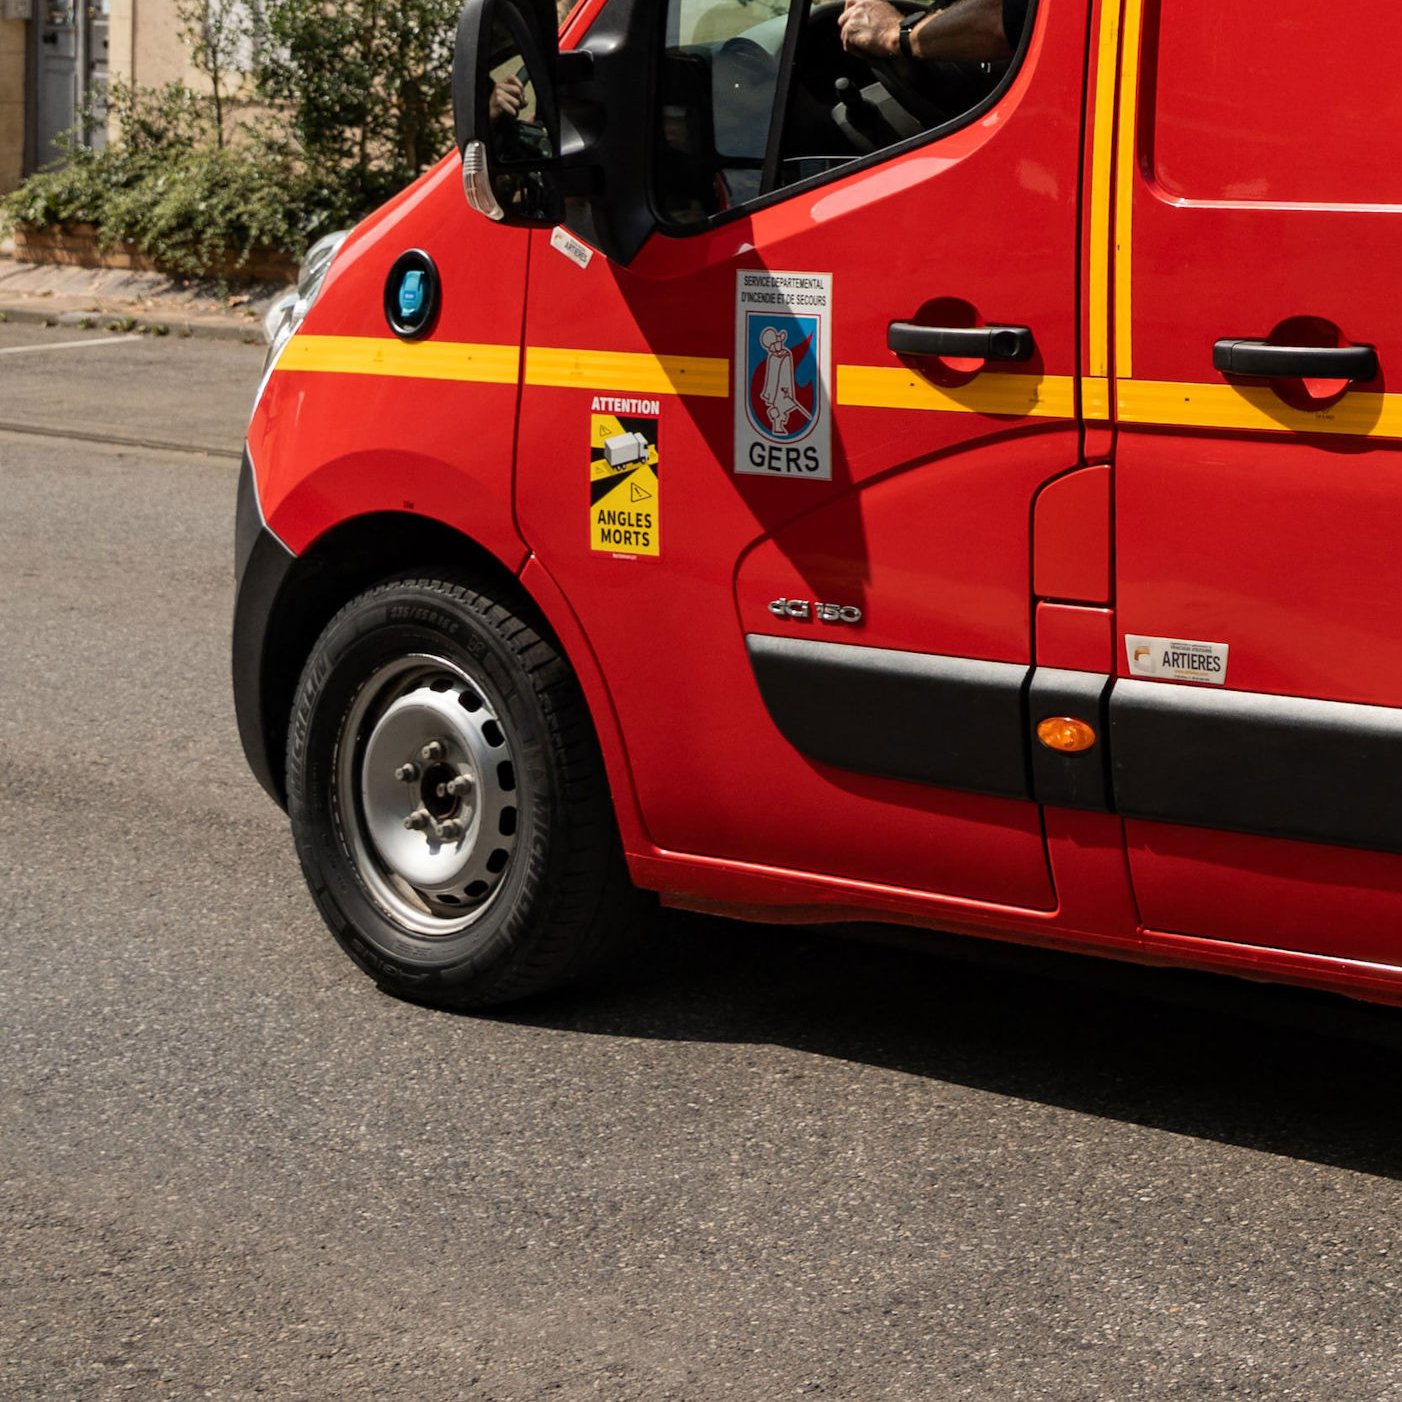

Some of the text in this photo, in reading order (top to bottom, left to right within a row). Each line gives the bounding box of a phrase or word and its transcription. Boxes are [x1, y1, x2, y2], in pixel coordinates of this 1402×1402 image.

[743, 275, 770, 288] SERVICE
[777, 292, 785, 304] ET
[786, 293, 795, 305] DE
[796, 294, 827, 306] SECOURS
[591, 396, 660, 415] ATTENTION
[749, 441, 819, 472] GERS
[597, 509, 652, 529] ANGLES
[600, 527, 650, 547] MORTS
[814, 601, 862, 622] 150
[1162, 650, 1222, 672] ARTIERES
